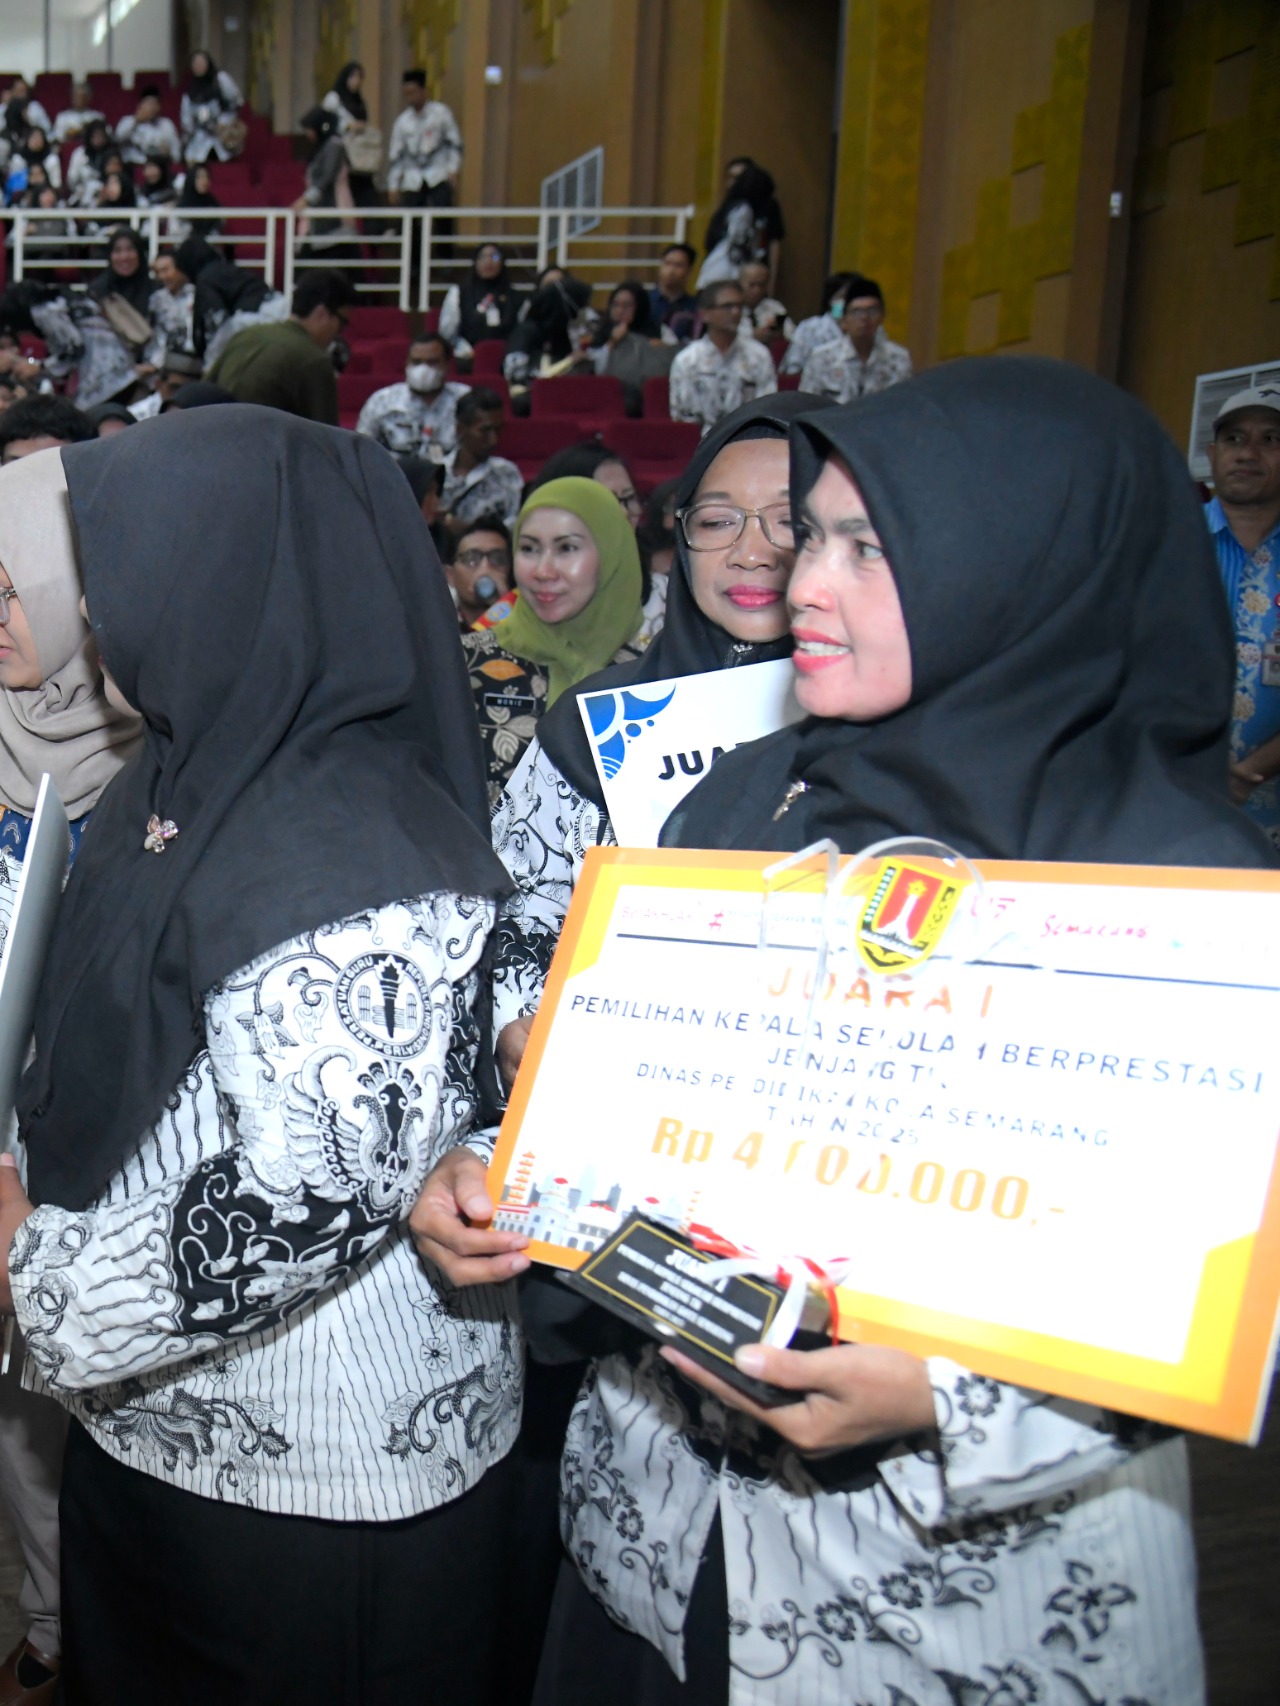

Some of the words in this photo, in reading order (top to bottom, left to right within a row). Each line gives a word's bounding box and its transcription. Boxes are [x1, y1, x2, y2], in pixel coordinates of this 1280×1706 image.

[346, 955, 375, 980] GURU
[768, 966, 954, 1014] JUARA
[570, 994, 706, 1027] PEMILIHAN
[1001, 1043, 1264, 1094] BERPRESTASI
[636, 1062, 702, 1086] DINAS
[865, 1095, 934, 1120] KOA
[947, 1108, 1108, 1146] SEMARANG
[650, 1116, 714, 1165] Rp
